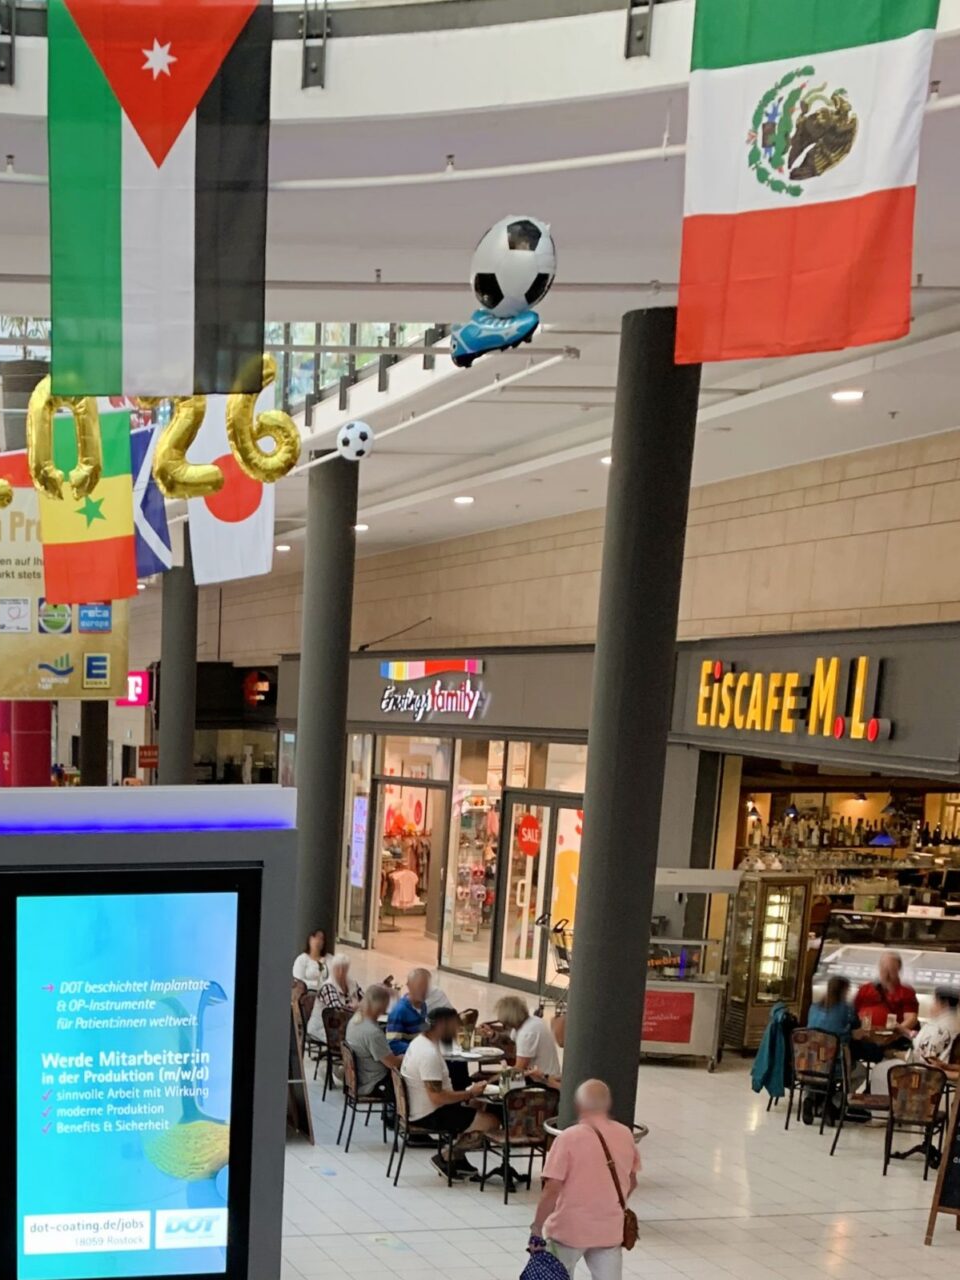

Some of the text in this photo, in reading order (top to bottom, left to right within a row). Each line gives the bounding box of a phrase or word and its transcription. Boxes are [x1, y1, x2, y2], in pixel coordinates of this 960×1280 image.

[14, 556, 31, 566] auf
[17, 570, 41, 579] stets
[432, 680, 481, 720] family
[521, 826, 540, 844] SALE
[60, 979, 211, 994] DOT beschichtet Implantate
[56, 999, 156, 1012] & OP-Instrumente
[56, 1017, 72, 1030] für
[75, 1016, 147, 1029] Patient:innen
[41, 1049, 210, 1069] Werde Mitarbeiter:in
[42, 1066, 210, 1085] in der Produktion (m/w/d)
[56, 1085, 209, 1101] sinnvolle Arbeit mit Wirkung
[56, 1103, 164, 1117] moderne Produktion
[56, 1119, 170, 1134] Benefits & Sicherheit
[30, 1218, 145, 1234] dot-coating.de/jobs
[165, 1215, 221, 1233] DOT
[107, 1235, 144, 1246] Rostock
